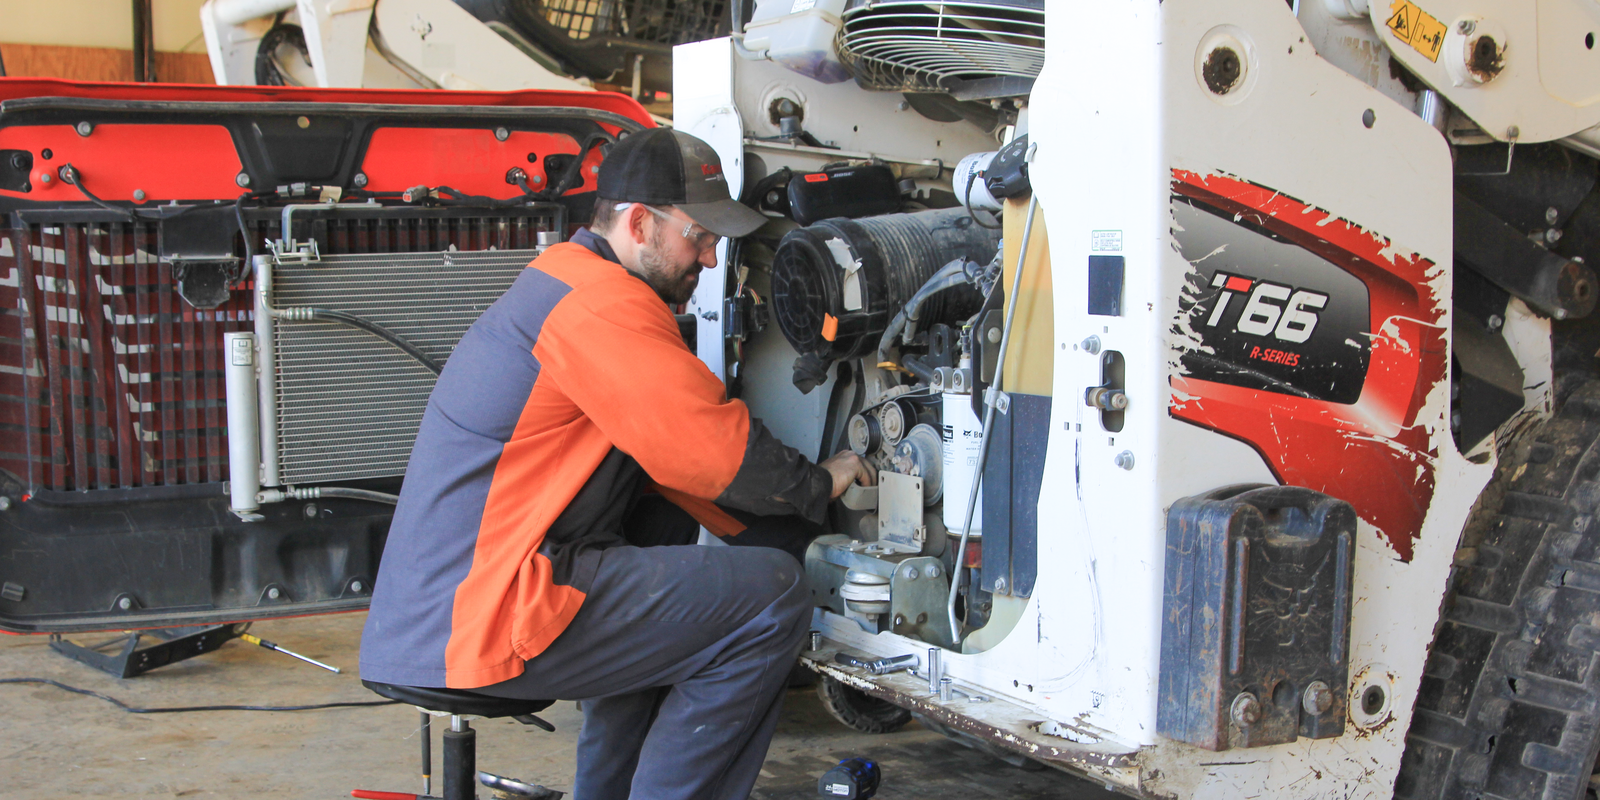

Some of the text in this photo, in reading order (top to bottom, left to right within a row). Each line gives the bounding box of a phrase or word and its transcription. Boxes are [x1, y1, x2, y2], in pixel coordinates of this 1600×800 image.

[1206, 272, 1329, 344] T66
[1249, 345, 1301, 367] R-SERIES
[973, 431, 983, 439] Bo
